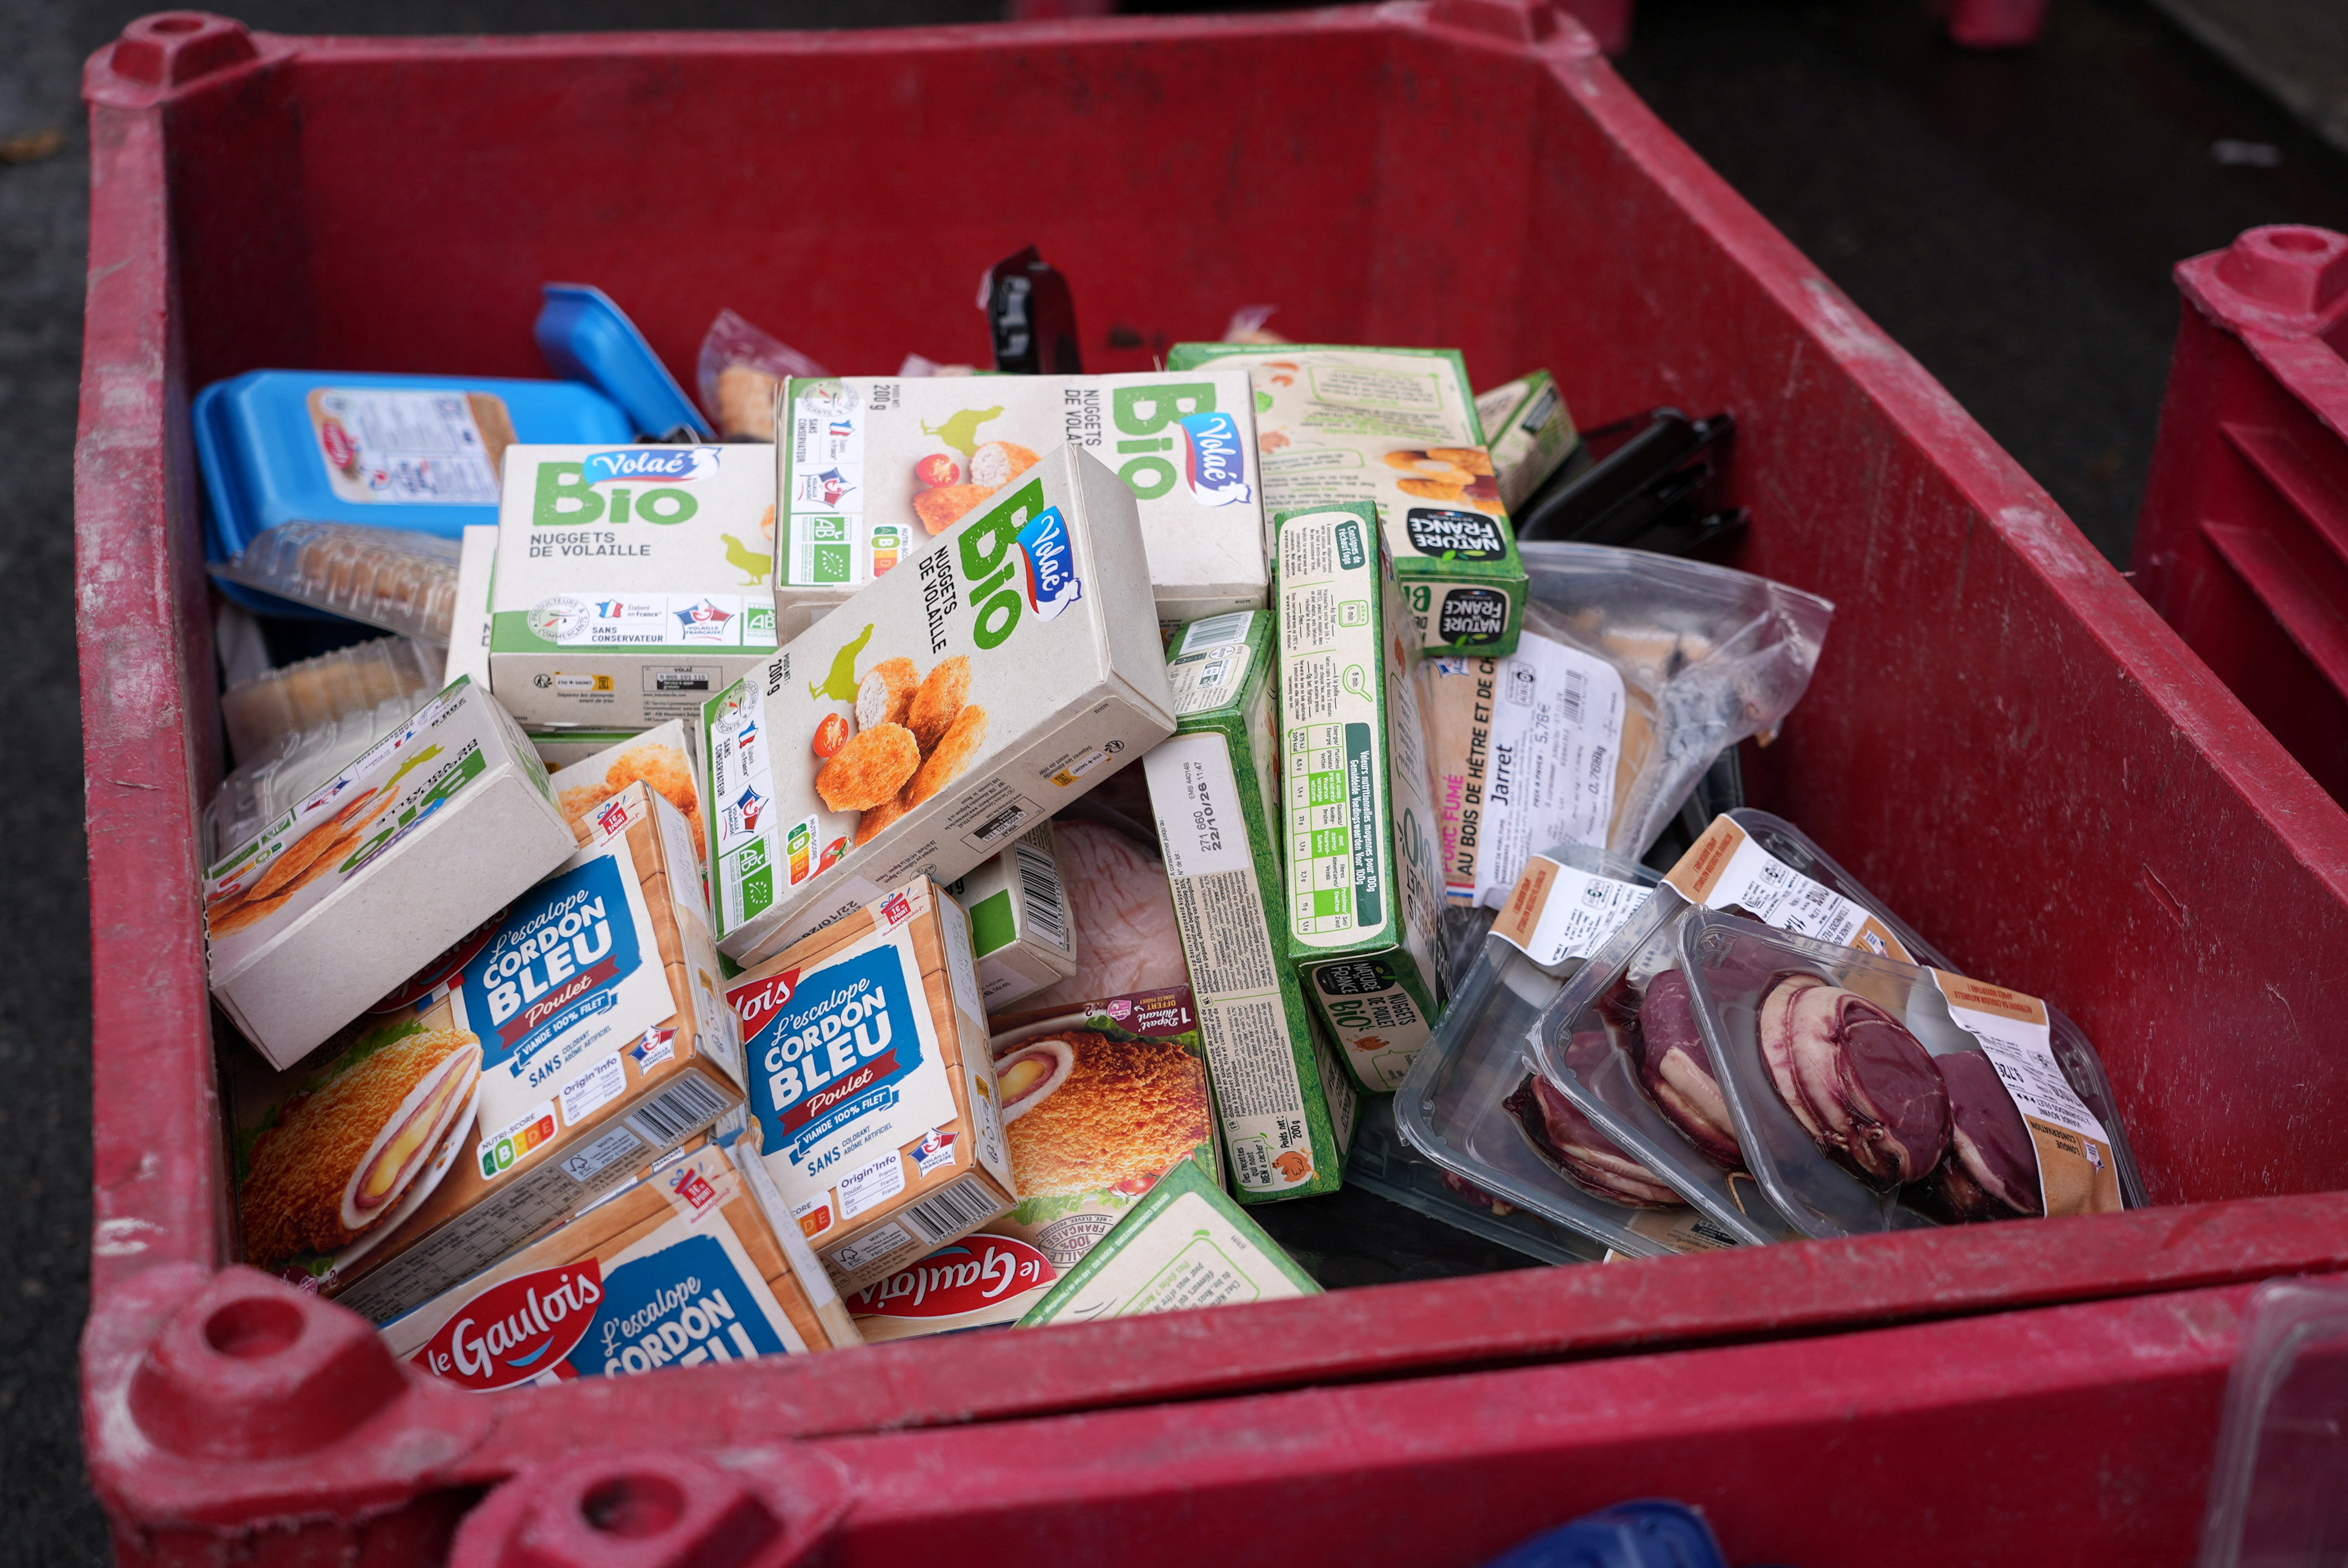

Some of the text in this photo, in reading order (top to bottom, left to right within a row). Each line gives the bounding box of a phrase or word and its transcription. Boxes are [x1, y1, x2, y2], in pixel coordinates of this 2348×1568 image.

[873, 384, 890, 402] 200
[1065, 389, 1082, 405] DE
[809, 419, 818, 435] SANS
[1084, 389, 1101, 446] NUGGETS
[796, 418, 806, 464] CONSERVATEUR
[1113, 383, 1217, 499] Bio
[1196, 417, 1238, 482] Volaé
[592, 451, 685, 476] Volaé
[532, 462, 698, 525] Bio
[530, 532, 615, 545] NUGGETS
[1347, 525, 1359, 555] Consignes
[1409, 518, 1493, 538] FRANCE
[1410, 533, 1499, 551] NATURE
[529, 544, 651, 557] DE VOLAILLE
[1032, 515, 1068, 591] Volaé
[1337, 528, 1352, 565] réchauffage
[957, 477, 1044, 649] Bio
[934, 544, 957, 615] NUGGETS
[919, 556, 947, 652] DE VOLAILLE
[1444, 600, 1502, 618] FRANCE
[591, 635, 663, 643] CONSERVATEUR
[592, 626, 617, 635] SANS
[1442, 617, 1501, 633] NATURE
[768, 658, 782, 696] 200 g
[734, 680, 759, 710] PRODUCTEURS
[715, 743, 724, 798] CONSERVATEUR
[1182, 762, 1195, 799] EMB 44014B
[1458, 675, 1493, 876] AU BOIS DE HÊTRE ET DE
[1490, 744, 1513, 806] Jarret
[1193, 761, 1222, 852] 22/10/26 11:47
[1444, 772, 1464, 821] FUMÉ
[606, 814, 626, 834] 1POINT
[1193, 811, 1211, 852] 271 660
[1348, 759, 1366, 885] Gemiddelde Voedingswaarden Voor 100g
[1359, 750, 1377, 892] Valeurs nutritionnelles moyennes pour 100g
[809, 818, 817, 860] NUTRI-SCORE
[1158, 819, 1173, 871] consommer jusqu'au
[1316, 834, 1324, 853] Suikers
[740, 848, 757, 872] AB
[890, 907, 909, 925] 1POINT
[1332, 891, 1341, 912] Eiwitten
[491, 888, 589, 963] L'escalope
[483, 896, 606, 990] CORDON
[1180, 906, 1203, 994] Bereiding gepekeld
[486, 919, 613, 1027] BLEU
[1330, 965, 1358, 994] FRANCE
[1353, 962, 1381, 991] NATURE
[524, 975, 593, 1028] Poulet
[772, 977, 871, 1046] L'escalope
[1137, 1008, 1178, 1022] Aimant
[1146, 999, 1176, 1010] OFFERT
[1180, 1006, 1191, 1023] 1
[1366, 997, 1396, 1029] DE POULET
[1387, 992, 1417, 1026] NUGGETS
[522, 1011, 580, 1056] VIANDE 100%
[562, 1029, 590, 1055] COLORANT
[564, 1025, 612, 1064] ARÔME ARTIFICIEL
[764, 986, 887, 1073] CORDON
[641, 1049, 672, 1069] FRANÇAISE
[642, 1046, 670, 1064] VOLAILLE
[769, 1009, 893, 1111] BLEU
[529, 1054, 562, 1089] SANS
[1994, 1061, 2024, 1083] 9.72€
[806, 1066, 873, 1117] Poulet
[1218, 1087, 1228, 1118] Préparation
[802, 1103, 861, 1143] VIANDE 100%
[1228, 1121, 1237, 1129] FR
[2037, 1107, 2060, 1121] BOVINE
[482, 1112, 537, 1150] NUTRI-SCORE
[597, 1135, 615, 1148] MIXTE
[842, 1125, 871, 1147] COLORANT
[843, 1122, 893, 1157] ARÔME ARTIFICIEL
[1276, 1119, 1289, 1148] Poids net
[1290, 1125, 1301, 1139] 200
[2031, 1120, 2077, 1144] CONSERVATION
[807, 1146, 841, 1177] SANS
[921, 1153, 952, 1171] FRANÇAISE
[922, 1150, 949, 1167] VOLAILLE
[2056, 1139, 2081, 1155] LONGUE
[1237, 1146, 1250, 1183] Des recettes
[1249, 1166, 1259, 1177] qui
[1255, 1144, 1270, 1184] RIEN cacher
[843, 1165, 898, 1198] Poulet France
[844, 1174, 899, 1207] Blé France
[846, 1183, 901, 1216] Lait France
[938, 1206, 997, 1241] 266980 033613
[1114, 1192, 1170, 1247] SERVICE CONSOMMATEURS
[868, 1231, 886, 1242] MIXTE
[1051, 1224, 1106, 1249] FRANÇAISE
[1059, 1235, 1091, 1250] 100%
[848, 1256, 864, 1267] FSC
[1020, 1261, 1040, 1282] le
[1187, 1269, 1216, 1297] d'éleveurs
[1197, 1287, 1214, 1304] Nous
[1224, 1278, 1241, 1296] Chez
[428, 1273, 600, 1379] le Gaulois
[601, 1275, 702, 1355] L'escalope
[604, 1289, 735, 1379] CORDON
